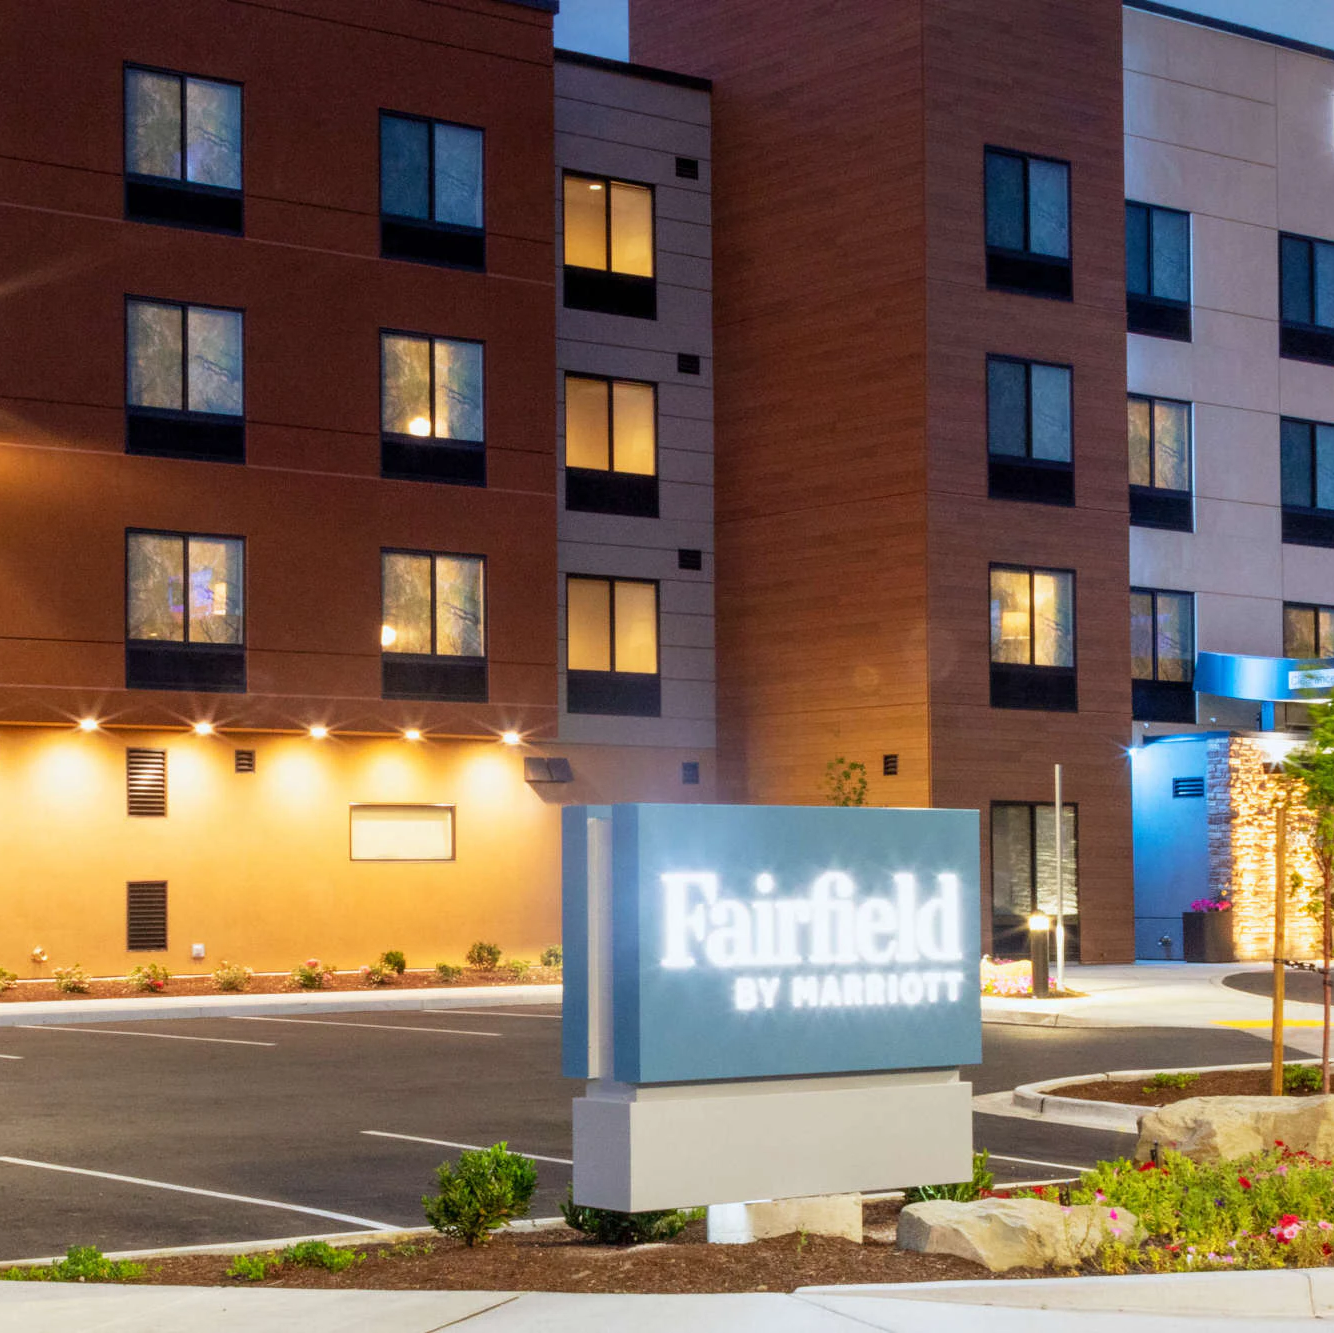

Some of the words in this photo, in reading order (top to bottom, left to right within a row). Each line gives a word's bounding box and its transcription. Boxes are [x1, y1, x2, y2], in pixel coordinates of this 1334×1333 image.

[660, 871, 963, 969] Fairfield
[734, 976, 780, 1010] BY
[791, 972, 964, 1008] MARRIOTT
